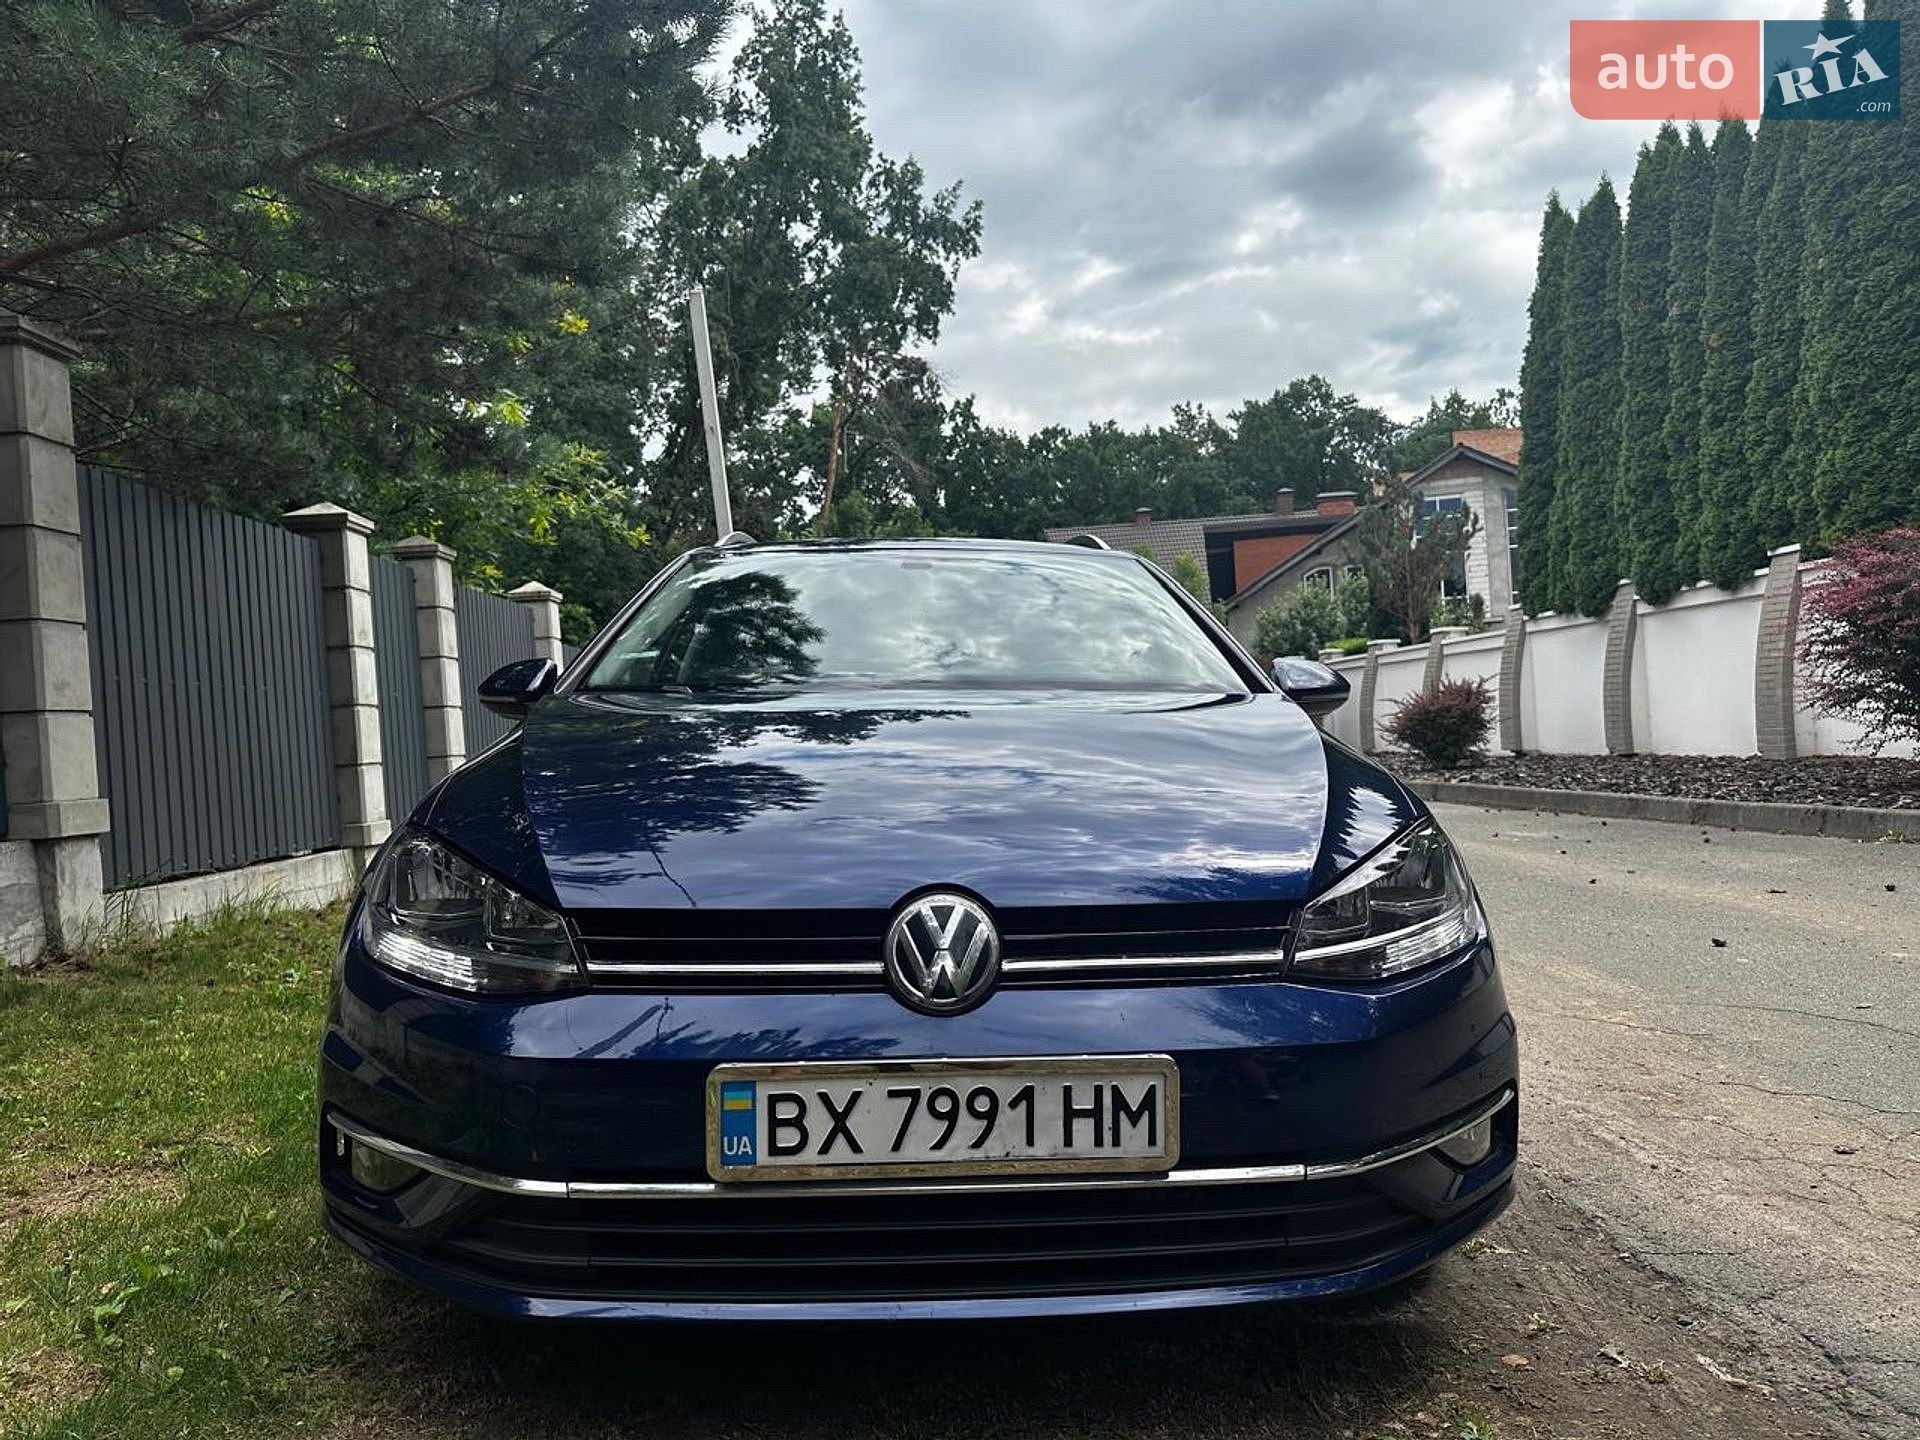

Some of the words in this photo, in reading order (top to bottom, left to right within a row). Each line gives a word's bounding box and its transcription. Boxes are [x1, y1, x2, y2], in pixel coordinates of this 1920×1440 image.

[766, 1089, 865, 1158] BX
[886, 1082, 1035, 1152] 7991
[1062, 1081, 1157, 1149] HM
[723, 1135, 753, 1156] UA
